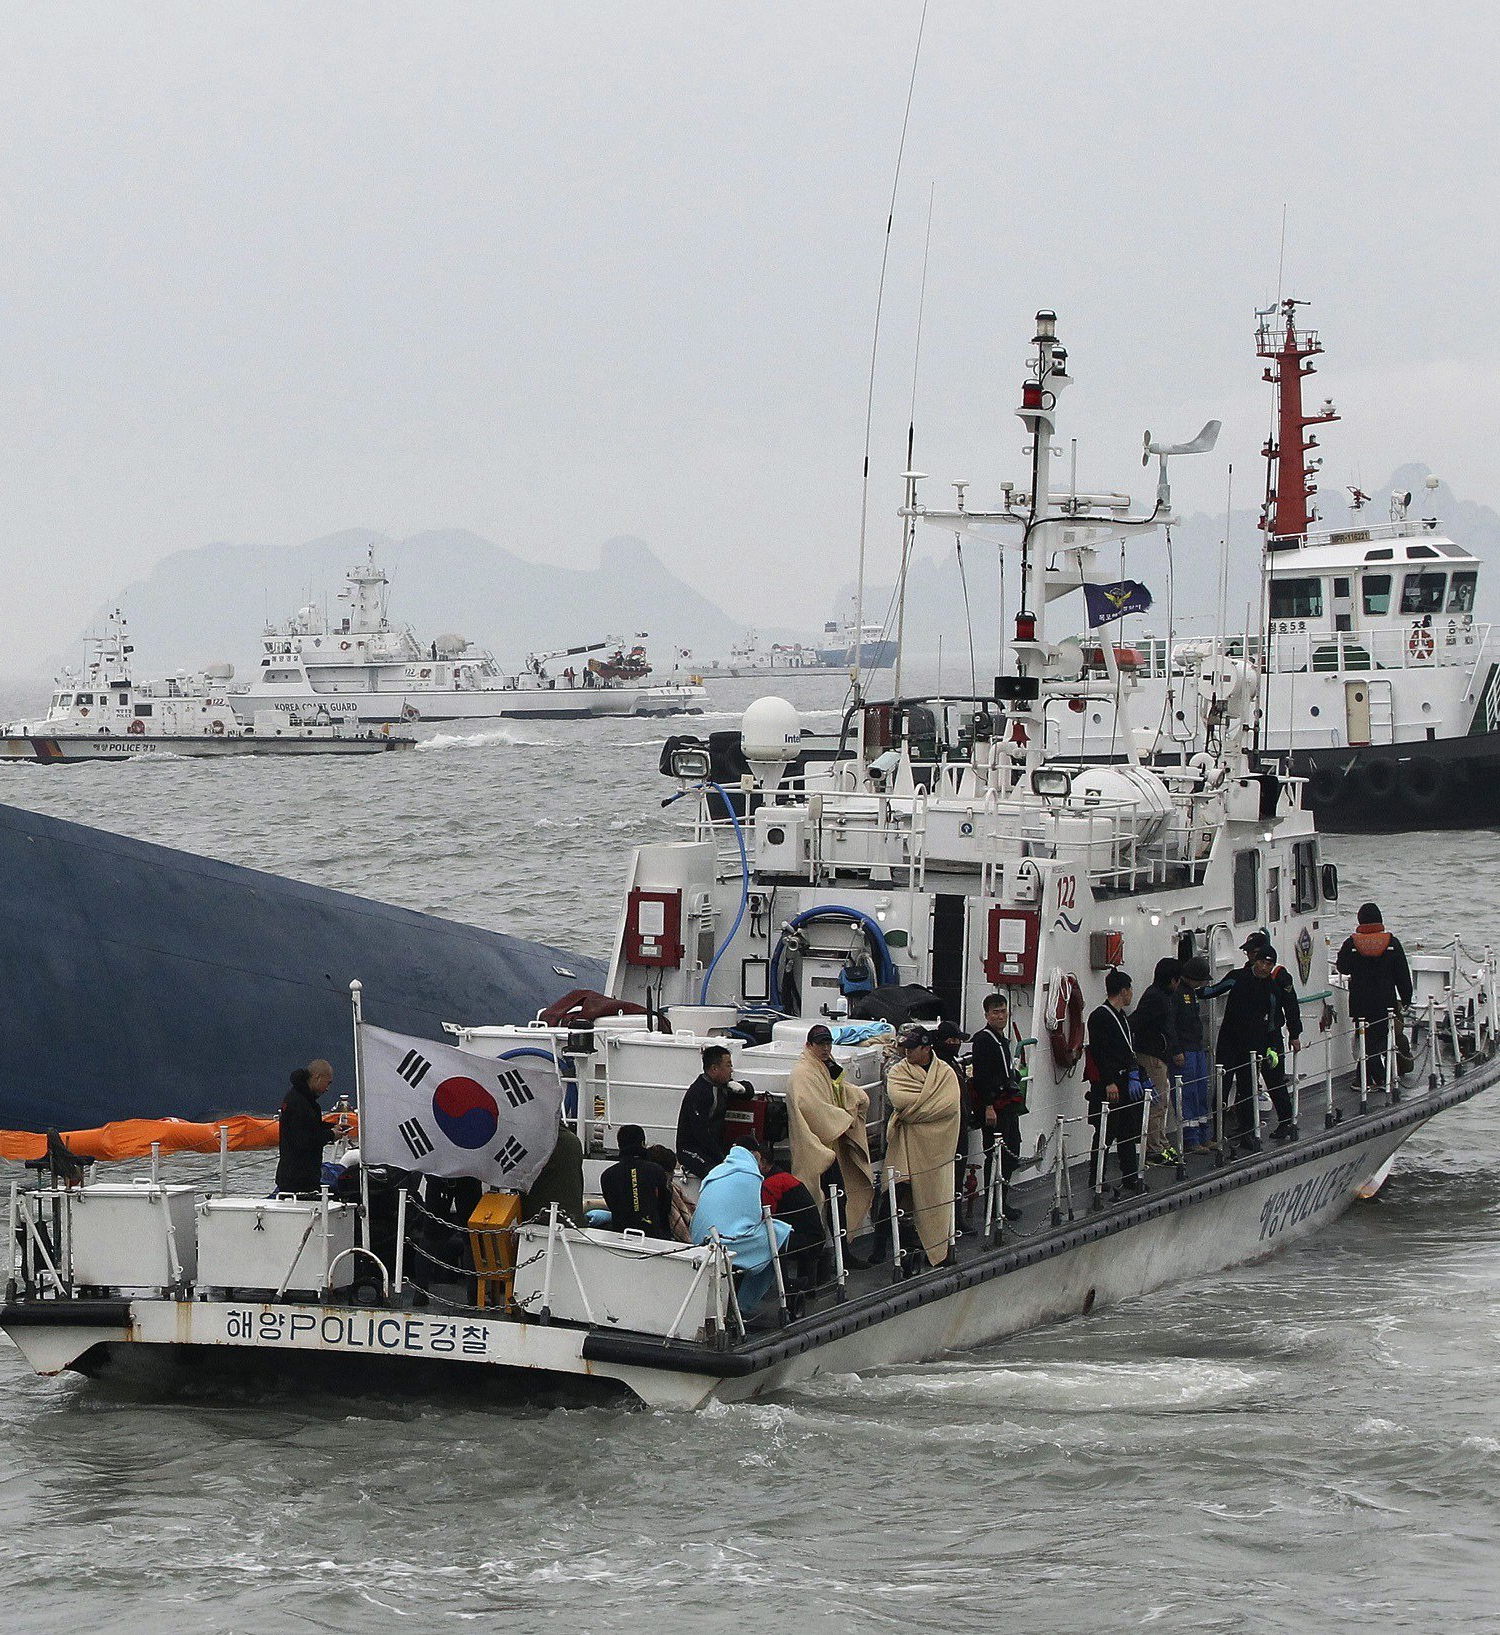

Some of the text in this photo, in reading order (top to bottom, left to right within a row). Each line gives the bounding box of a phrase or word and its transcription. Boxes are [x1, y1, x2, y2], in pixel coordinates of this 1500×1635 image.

[274, 703, 300, 711] KOREA
[330, 703, 358, 711] GUARD
[1056, 875, 1076, 910] 122
